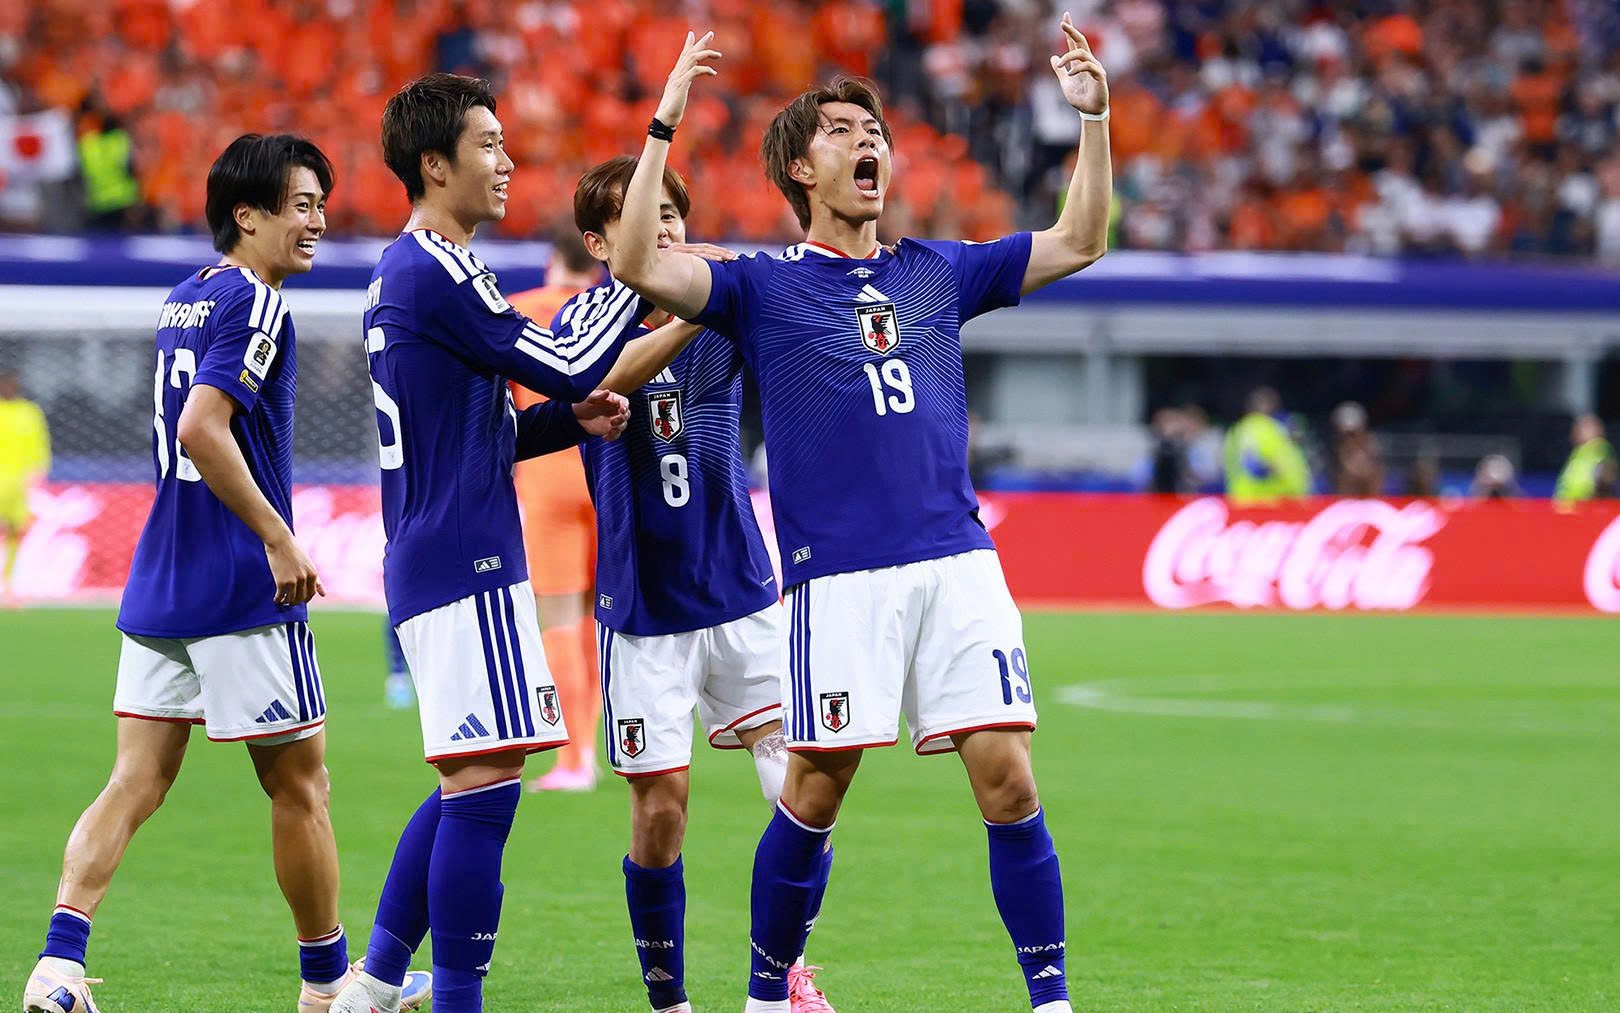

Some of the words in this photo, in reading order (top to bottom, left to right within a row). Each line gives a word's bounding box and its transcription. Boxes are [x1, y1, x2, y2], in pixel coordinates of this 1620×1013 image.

[865, 306, 886, 314] JAPAN
[863, 358, 916, 416] 19
[659, 454, 691, 508] 8
[992, 647, 1032, 705] 19
[633, 937, 675, 949] APAN
[750, 936, 789, 969] APAN
